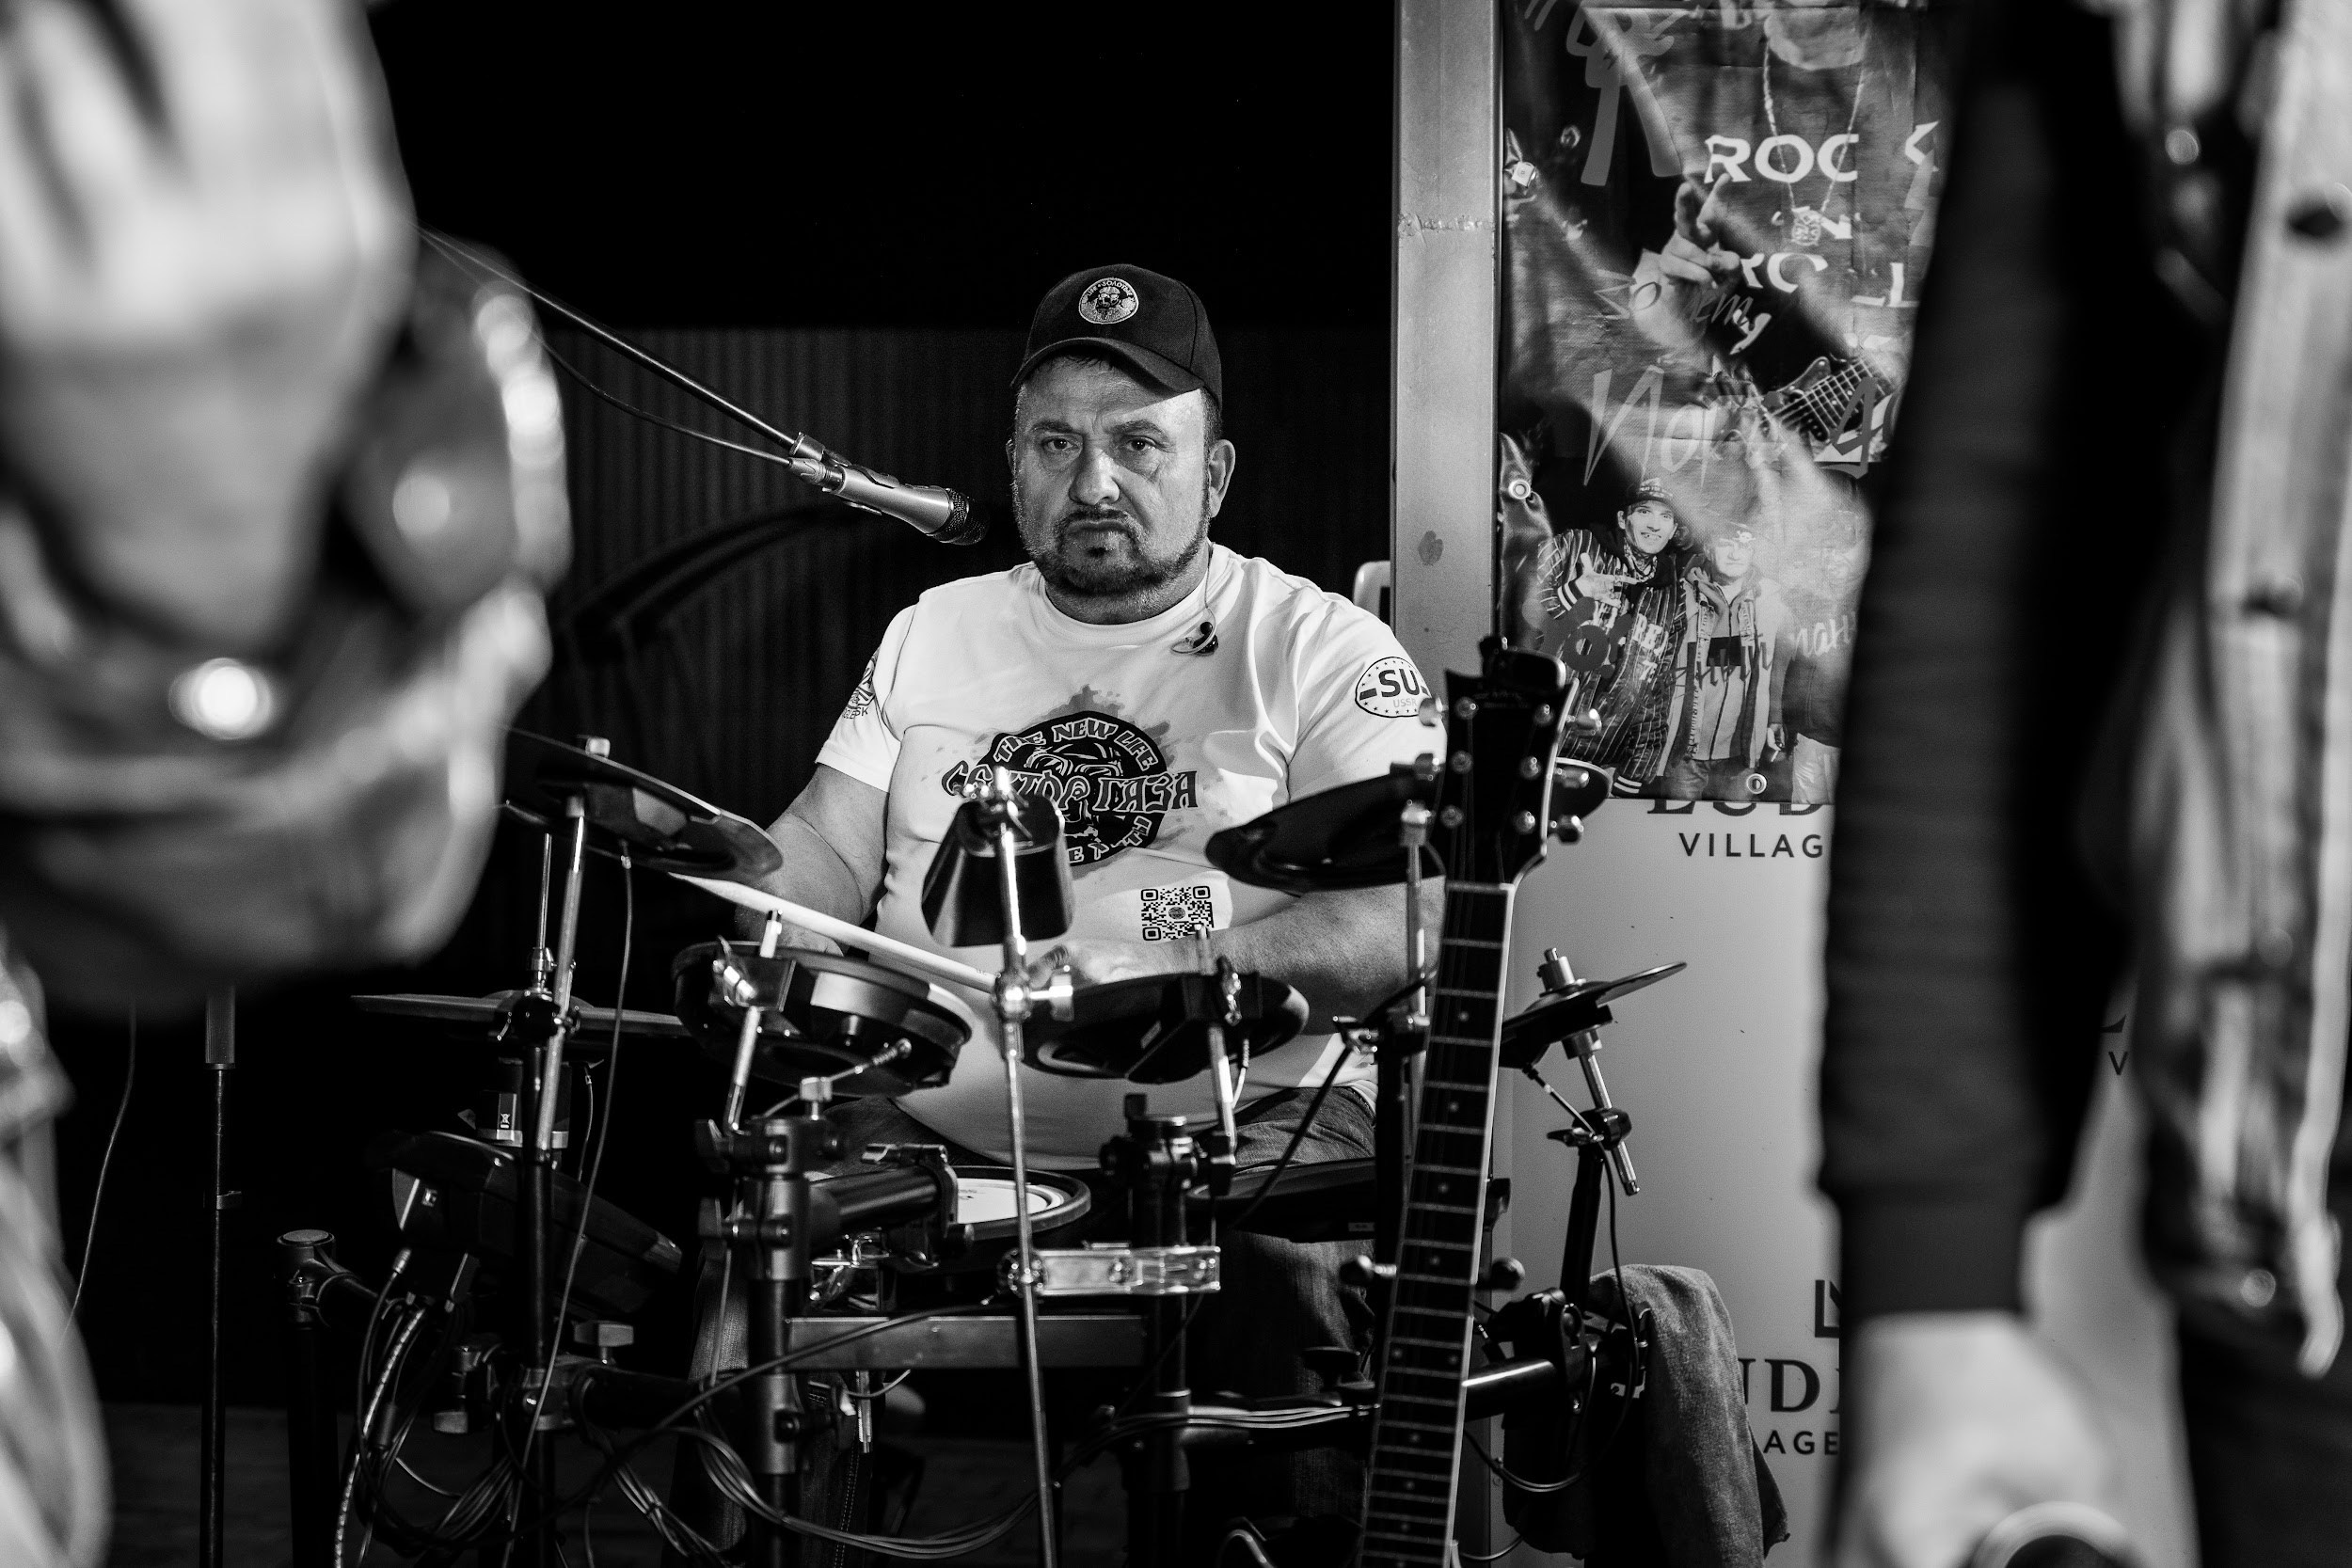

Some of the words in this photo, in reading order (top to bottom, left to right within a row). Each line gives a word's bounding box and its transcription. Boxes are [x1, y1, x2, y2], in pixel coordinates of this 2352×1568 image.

[1392, 697, 1419, 708] USSR
[993, 731, 1047, 764] THE
[1052, 718, 1119, 743] NEW
[1114, 730, 1159, 772] LIFE
[1093, 769, 1200, 814] ГАЗА
